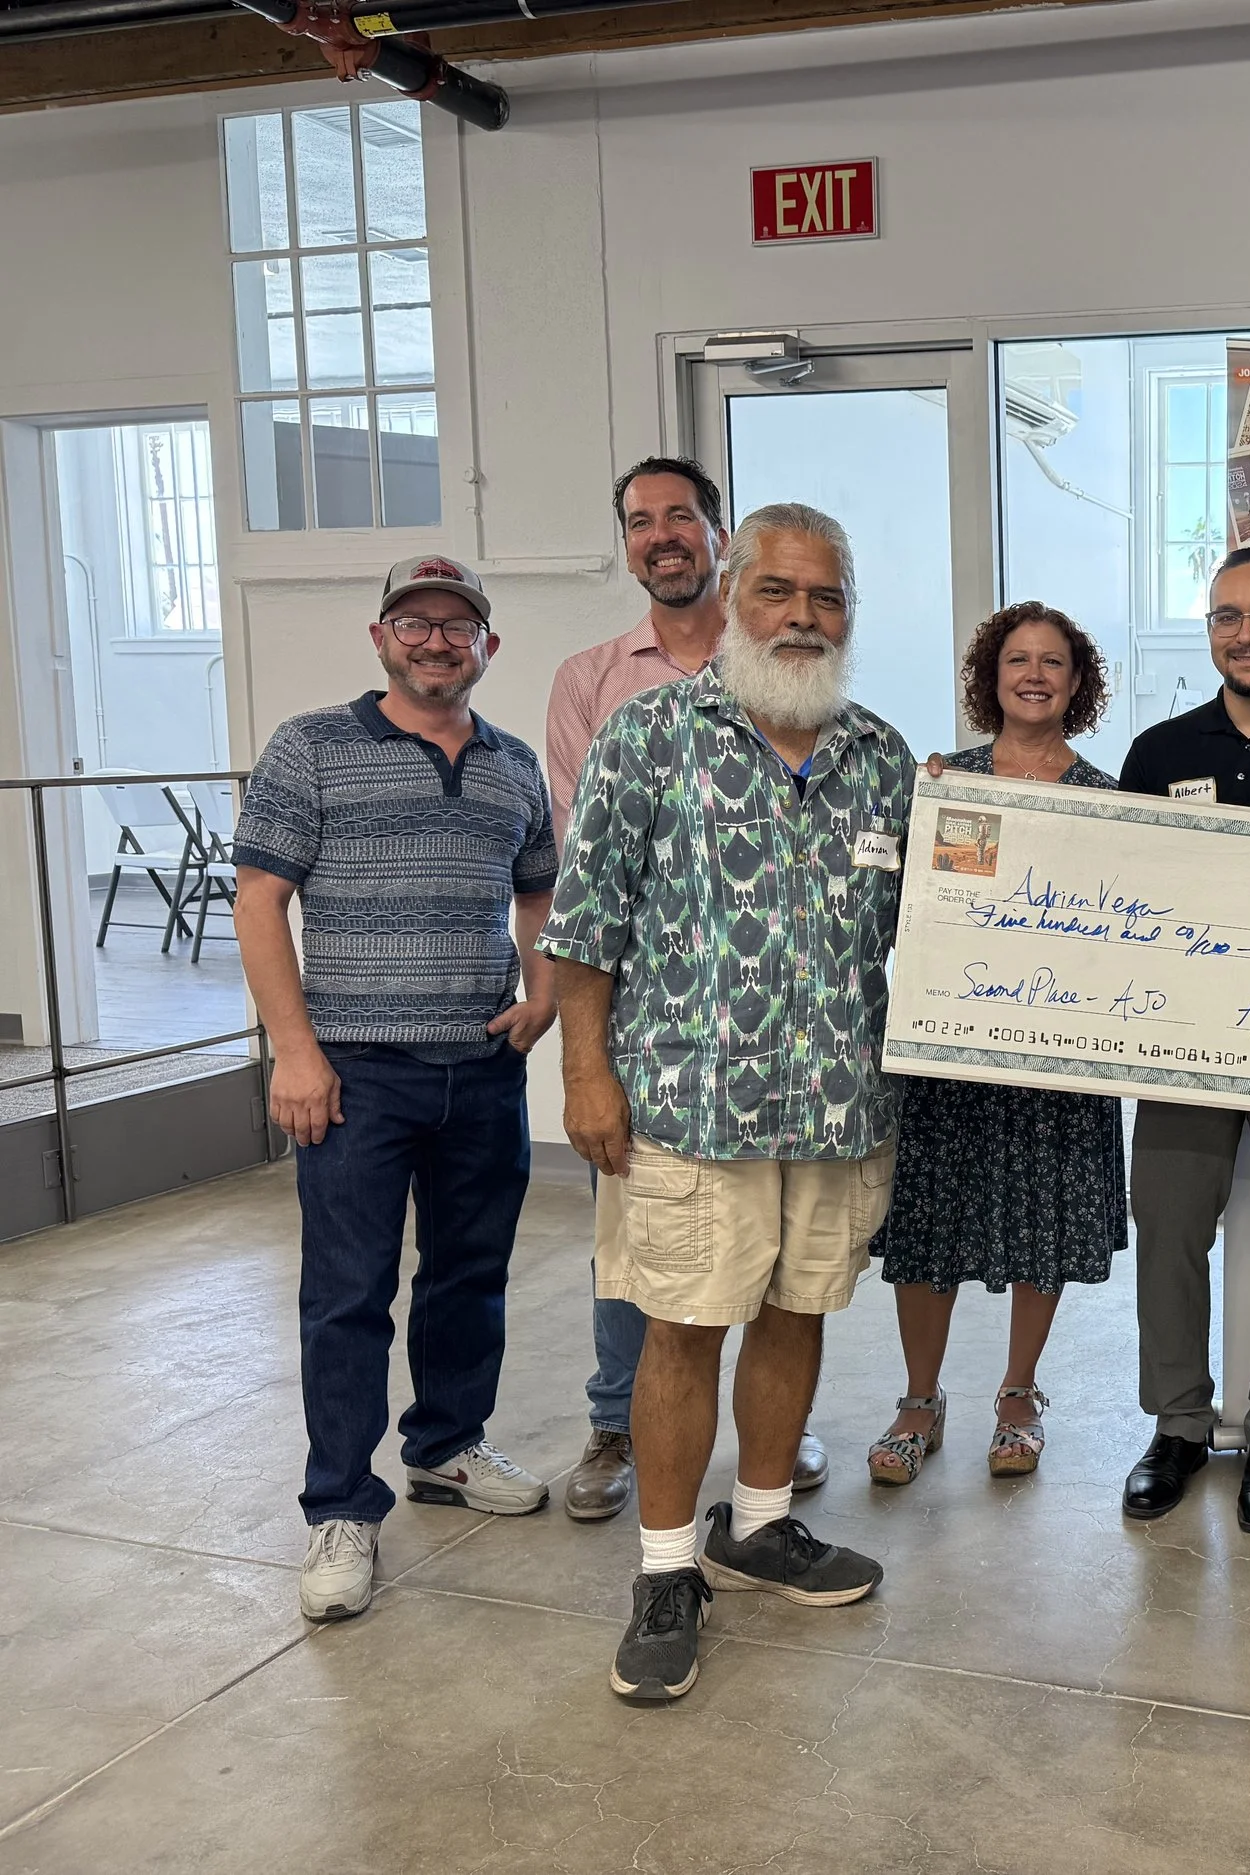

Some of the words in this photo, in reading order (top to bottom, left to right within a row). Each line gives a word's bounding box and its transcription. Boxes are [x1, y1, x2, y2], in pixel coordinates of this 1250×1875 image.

[775, 169, 857, 234] EXIT
[1174, 783, 1212, 798] Albert
[944, 825, 972, 835] PITCH
[937, 894, 964, 904] ORDER
[966, 890, 981, 898] THE
[1100, 874, 1174, 928] Vega
[966, 903, 1032, 929] Five
[1036, 909, 1109, 941] hundred
[1120, 926, 1162, 942] and
[925, 988, 951, 998] MEMO
[957, 962, 1024, 1001] Second
[1028, 967, 1081, 1007] Place
[1109, 979, 1168, 1021] AJO
